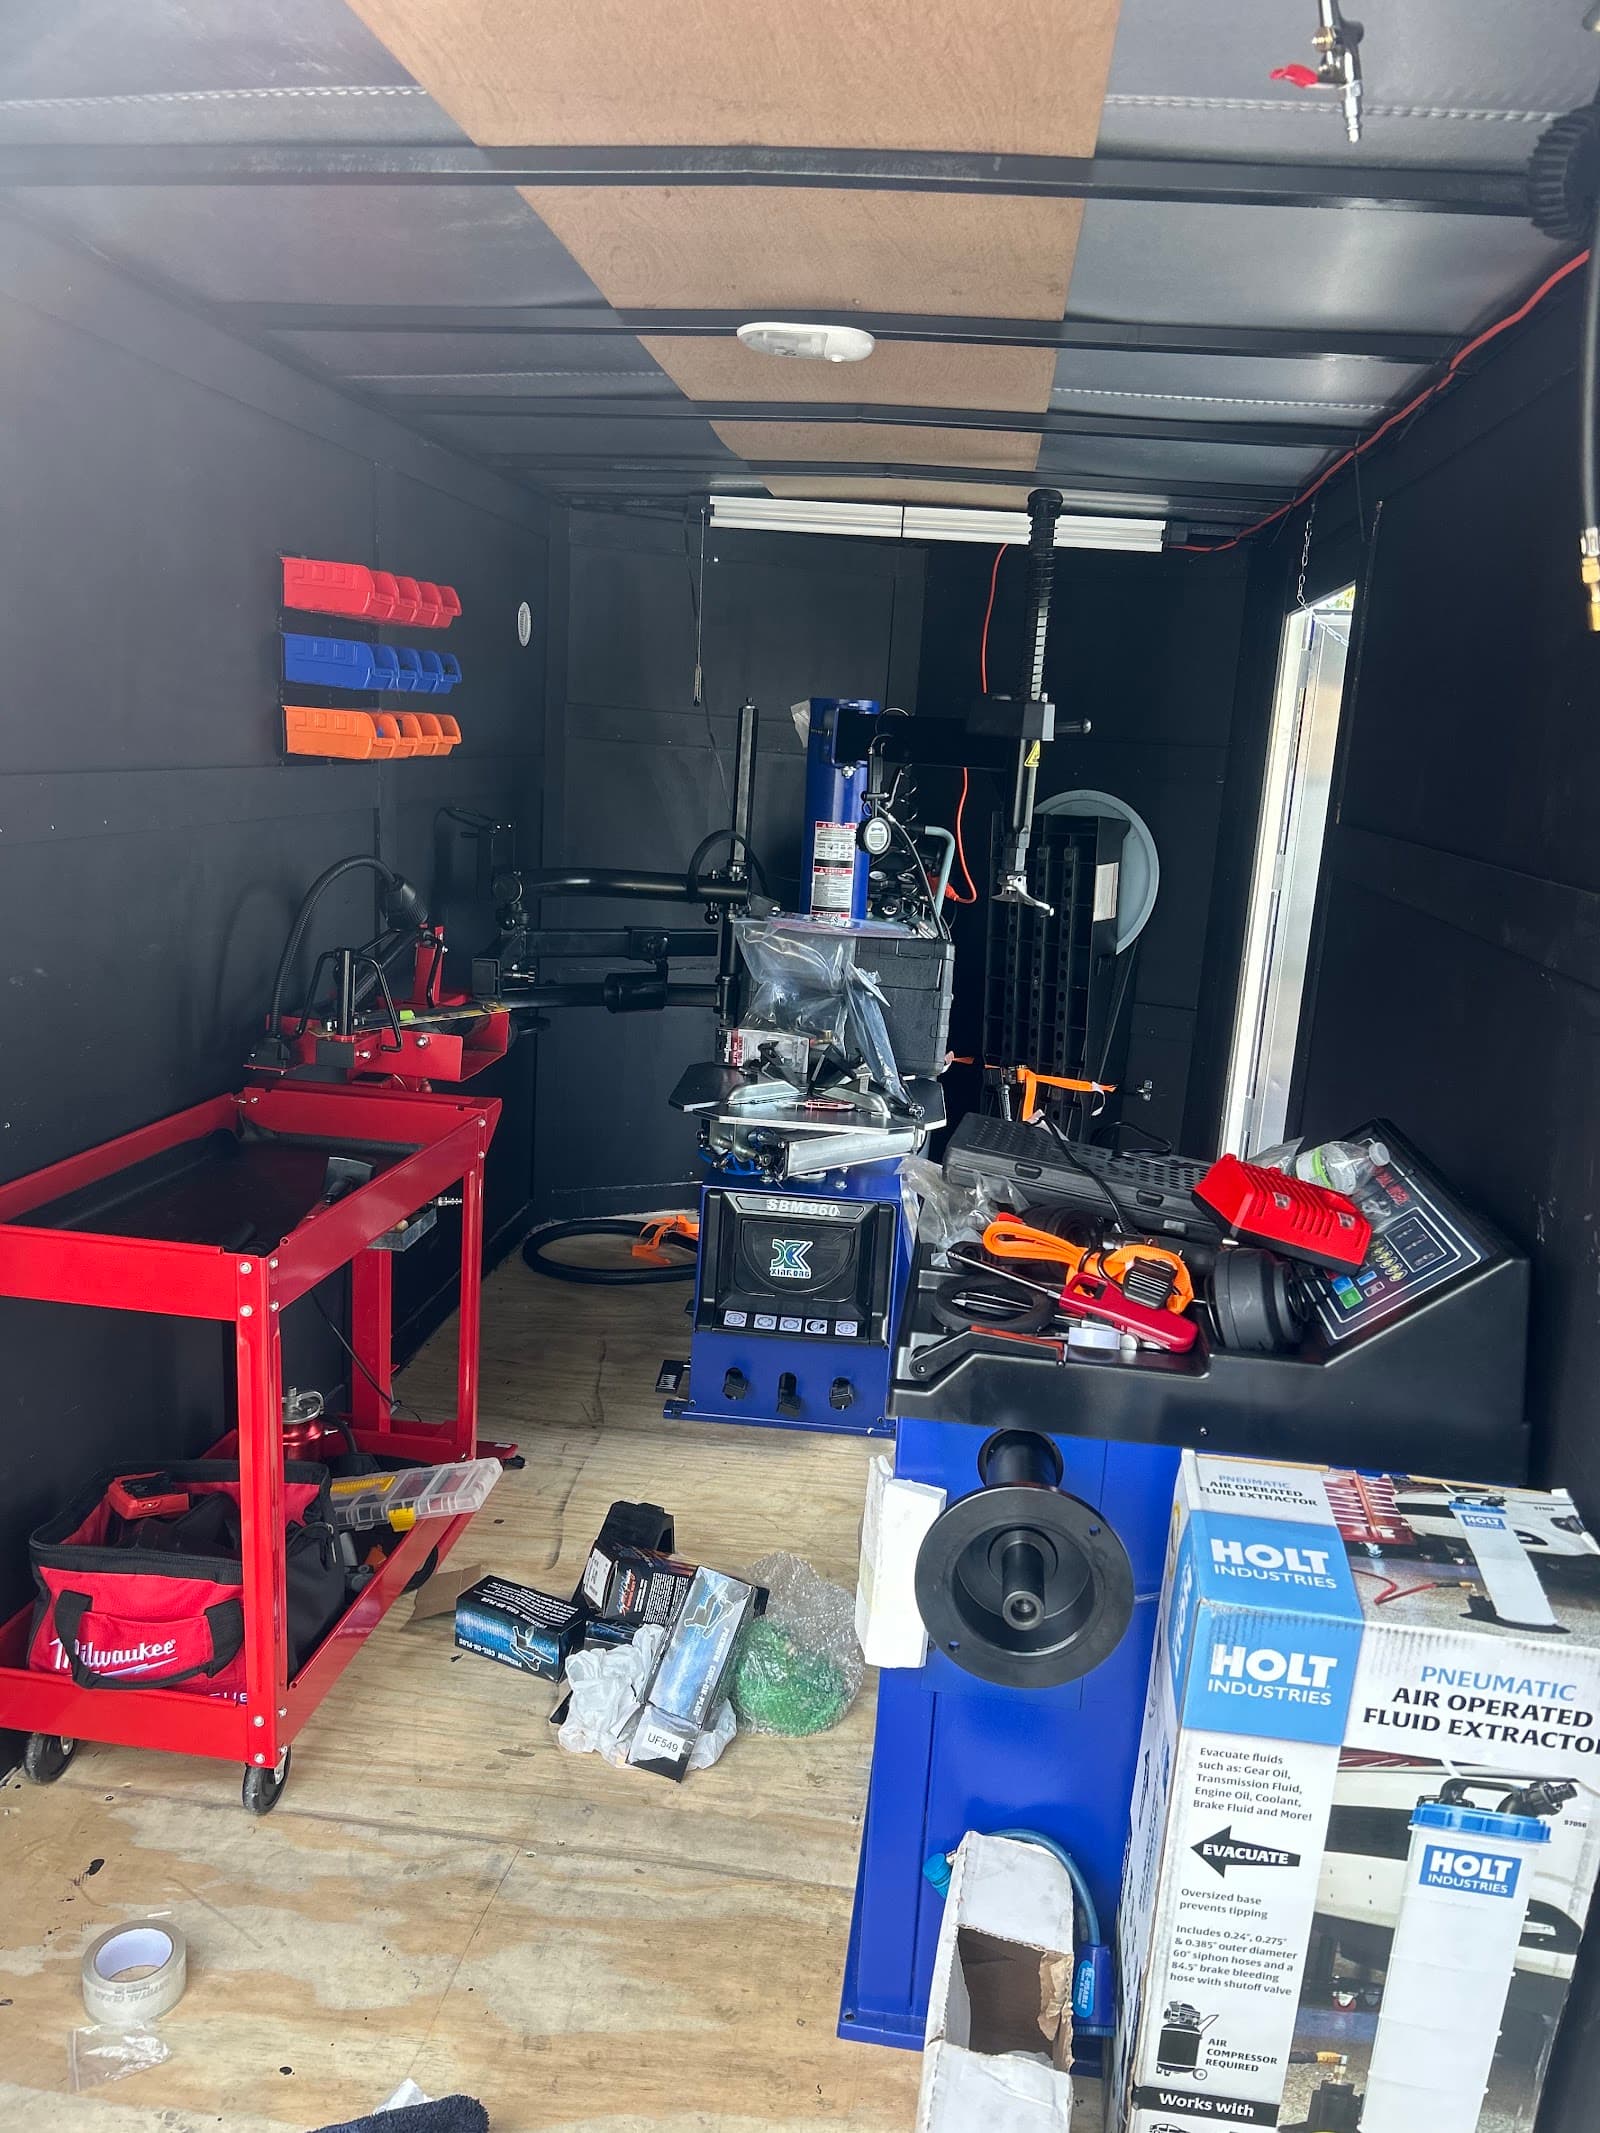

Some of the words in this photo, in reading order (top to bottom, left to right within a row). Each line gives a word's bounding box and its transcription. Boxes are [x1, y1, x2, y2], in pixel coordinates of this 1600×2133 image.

[1210, 1481, 1232, 1490] AIR
[1235, 1484, 1303, 1497] OPERATED
[1219, 1474, 1291, 1488] PNEUMATIC
[1200, 1486, 1236, 1496] FLUID
[1240, 1492, 1318, 1506] EXTRACTOR
[1464, 1515, 1500, 1525] HOLT
[1210, 1538, 1329, 1575] HOLT
[1214, 1564, 1337, 1589] INDUSTRIES
[1210, 1643, 1338, 1688] HOLT
[1208, 1678, 1332, 1706] INDUSTRIES
[1420, 1666, 1577, 1701] PNEUMATIC
[1392, 1688, 1440, 1708] AIR
[1447, 1694, 1593, 1728] OPERATED
[1363, 1707, 1440, 1732] FLUID
[648, 1732, 678, 1752] UF549
[1200, 1748, 1250, 1760] Evacuate
[1252, 1753, 1283, 1764] fluids
[1198, 1761, 1223, 1770] such
[1226, 1764, 1242, 1772] as:
[1244, 1766, 1270, 1776] Gear
[1272, 1770, 1291, 1780] Oil,
[1197, 1774, 1269, 1789] Transmission
[1272, 1782, 1303, 1794] Fluid,
[1195, 1787, 1232, 1798] Engine
[1234, 1791, 1252, 1802] Oil,
[1256, 1794, 1302, 1808] Coolant,
[1193, 1800, 1224, 1810] Brake
[1227, 1804, 1254, 1814] Fluid
[1256, 1806, 1278, 1816] and
[1280, 1810, 1312, 1822] More!
[1202, 1843, 1289, 1864] EVACUATE
[1429, 1850, 1514, 1882] HOLT
[1428, 1874, 1508, 1894] INDUSTRIES
[1181, 1888, 1234, 1901] Oversized
[1236, 1895, 1262, 1905] base
[1179, 1901, 1226, 1914] prevents
[1229, 1906, 1268, 1920] tipping
[1176, 1925, 1221, 1938] Includes
[1218, 1943, 1247, 1952] outer
[1249, 1946, 1298, 1959] diameter
[1192, 1952, 1229, 1964] siphon
[1231, 1956, 1261, 1967] hoses
[1264, 1960, 1284, 1970] and
[1287, 1964, 1294, 1972] a
[1200, 1964, 1230, 1976] brake
[1232, 1968, 1280, 1983] bleeding
[1170, 1972, 1195, 1982] hose
[1197, 1976, 1222, 1986] with
[1224, 1980, 1261, 1992] shutoff
[1264, 1986, 1292, 1996] valve
[1208, 2038, 1227, 2048] AIR
[1206, 2058, 1259, 2072] REQUIRED
[1207, 2048, 1278, 2064] COMPRESSOR
[1159, 2093, 1212, 2111] Works
[1216, 2101, 1254, 2118] with
